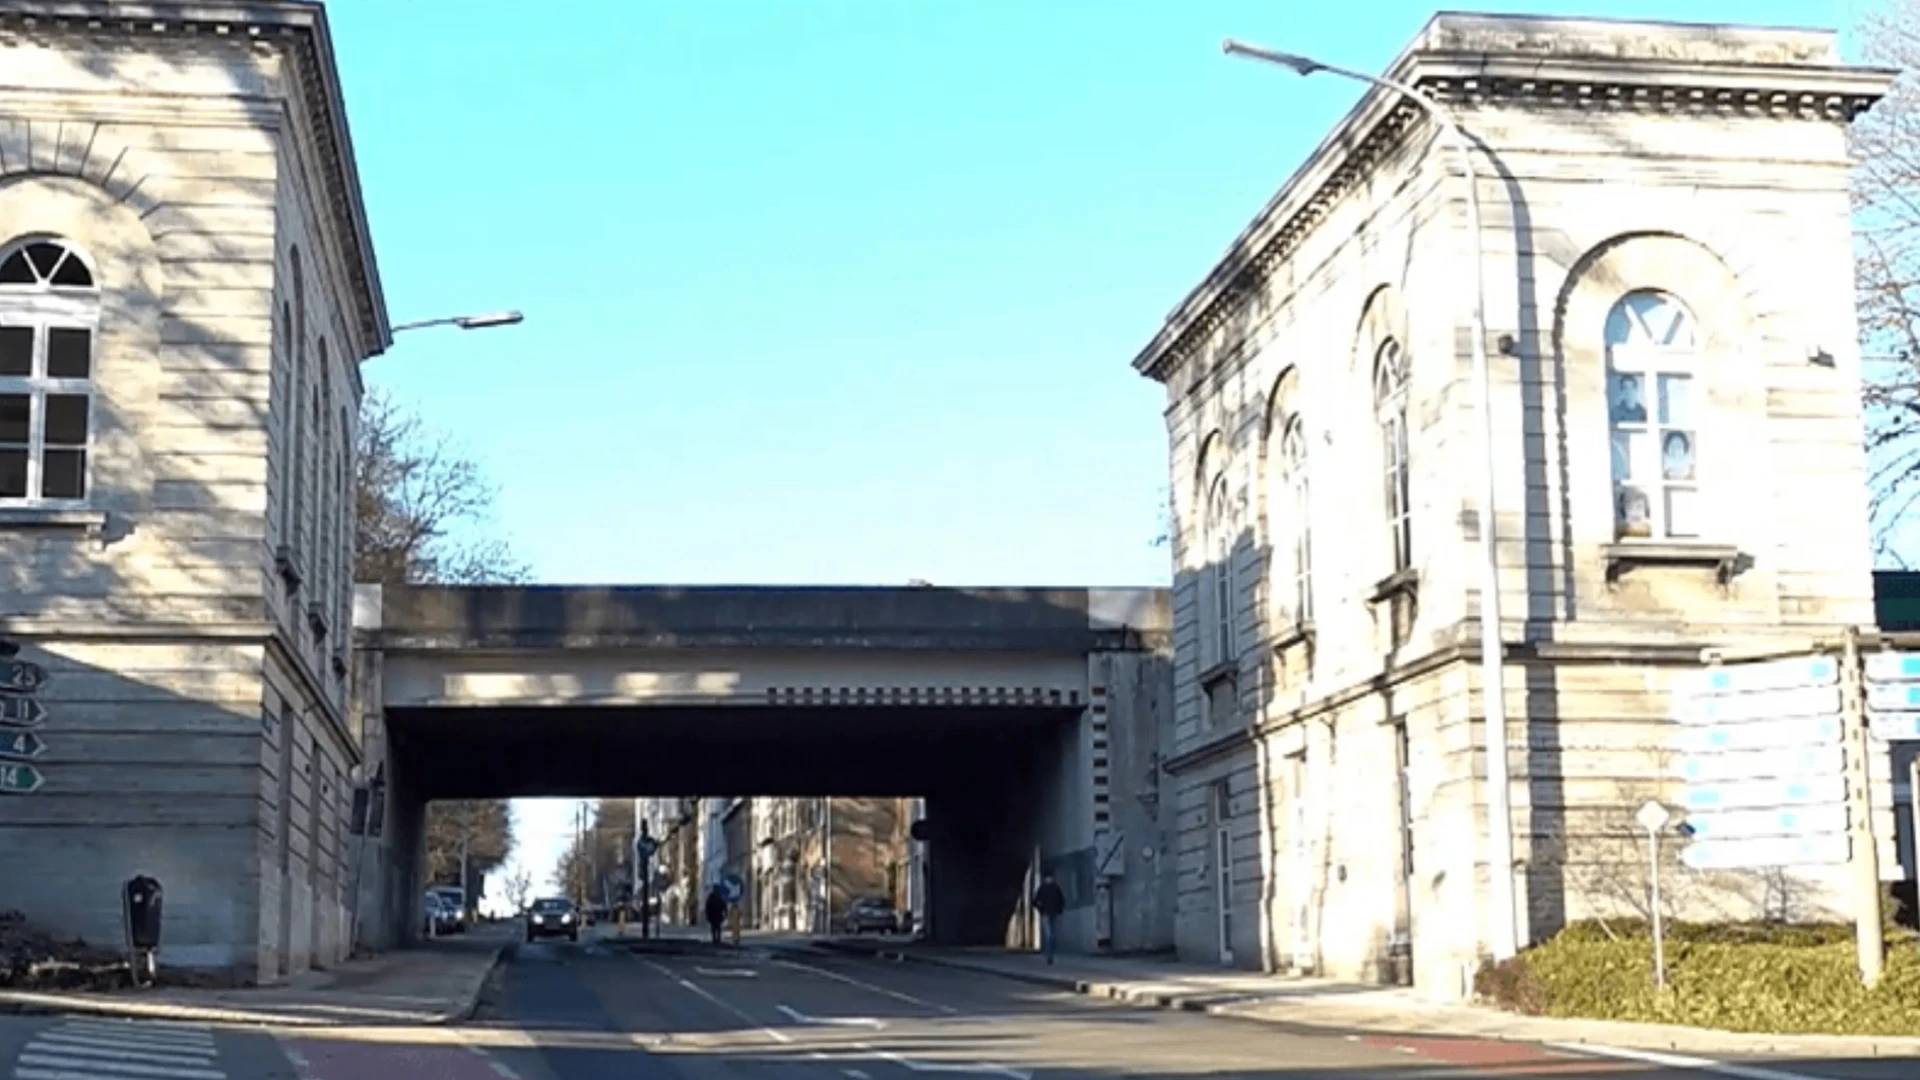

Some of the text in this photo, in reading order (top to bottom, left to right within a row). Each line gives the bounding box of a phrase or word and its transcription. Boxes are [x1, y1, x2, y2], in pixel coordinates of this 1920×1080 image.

[12, 664, 36, 686] 25
[16, 700, 29, 718] 11
[13, 735, 25, 752] 4
[0, 766, 17, 786] 14
